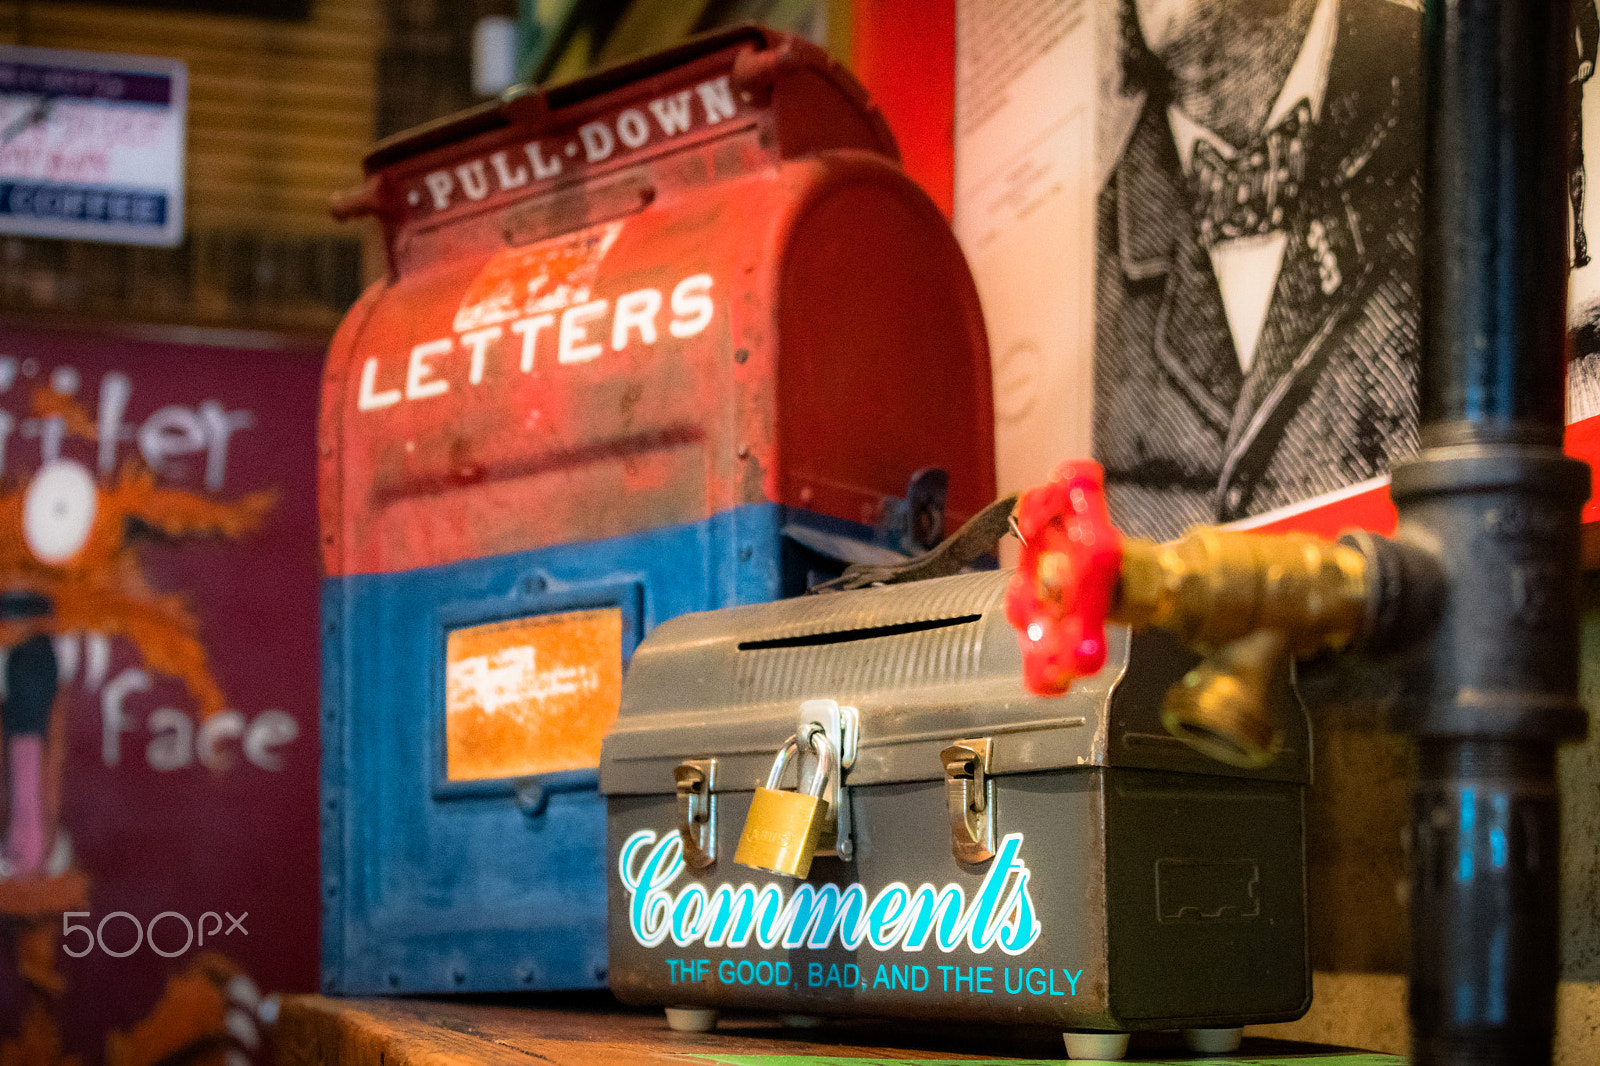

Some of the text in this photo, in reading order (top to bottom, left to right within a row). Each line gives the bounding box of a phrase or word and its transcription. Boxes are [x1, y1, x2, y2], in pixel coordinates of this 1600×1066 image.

[358, 273, 714, 412] LETTERS
[618, 829, 1042, 956] Comments
[718, 959, 798, 990] GOOD,
[808, 962, 868, 992] BAD,
[872, 963, 930, 992] AND
[937, 965, 994, 994] THE
[1004, 967, 1083, 997] UGLY
